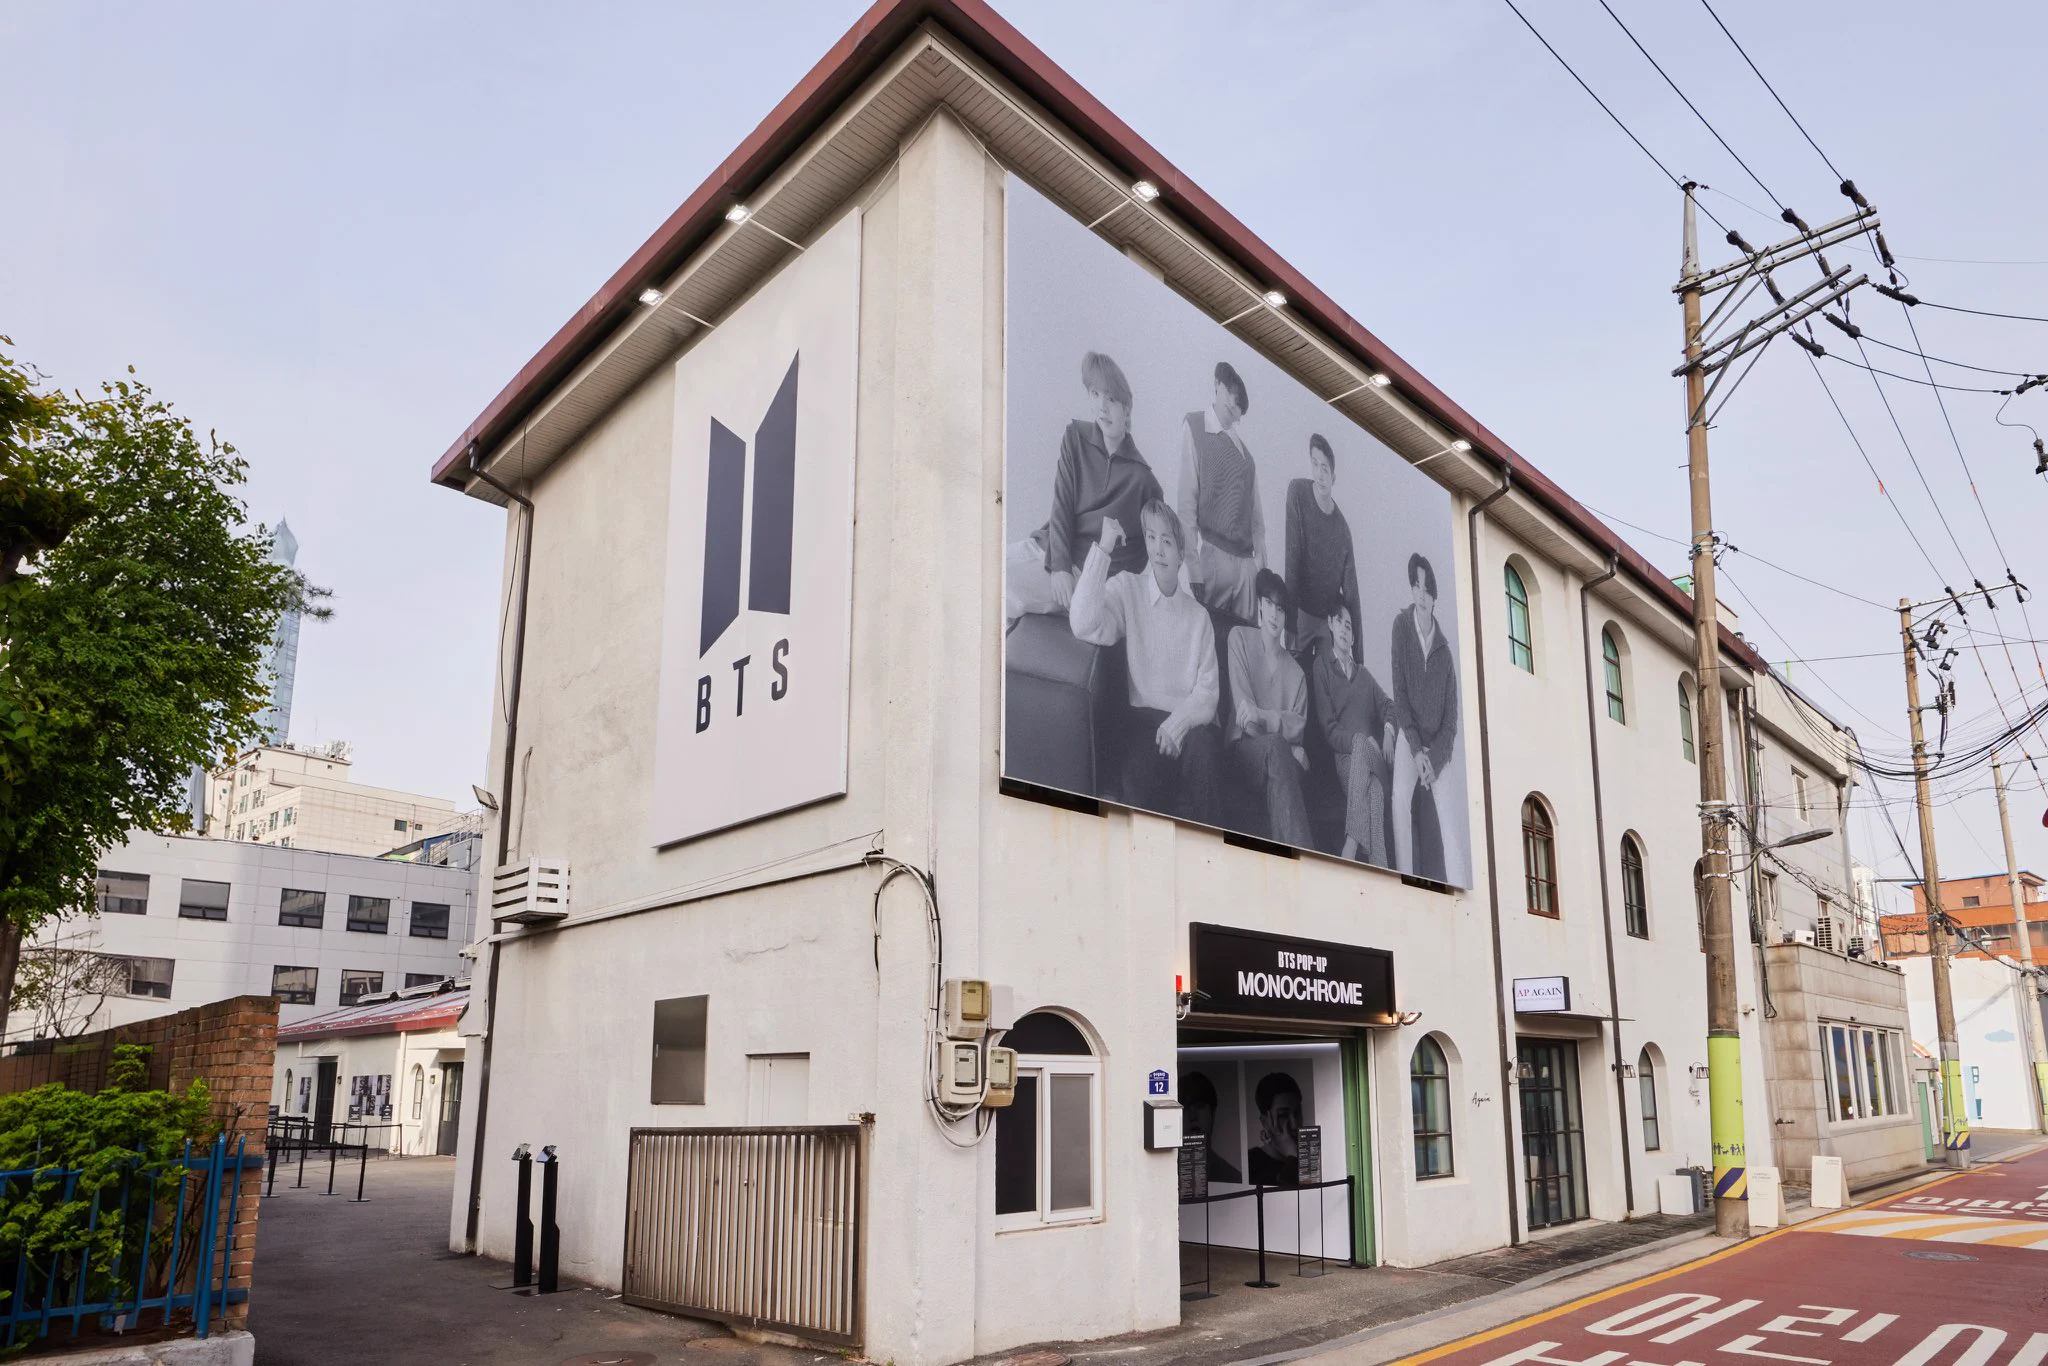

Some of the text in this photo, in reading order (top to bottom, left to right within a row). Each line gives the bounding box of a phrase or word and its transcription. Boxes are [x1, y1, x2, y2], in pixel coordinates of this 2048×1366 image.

[696, 638, 790, 734] BTS
[1277, 951, 1328, 973] BTS POP-UP
[1237, 970, 1363, 1006] MONOCHROME
[1532, 987, 1562, 996] AGAIN
[1154, 1081, 1164, 1093] 12
